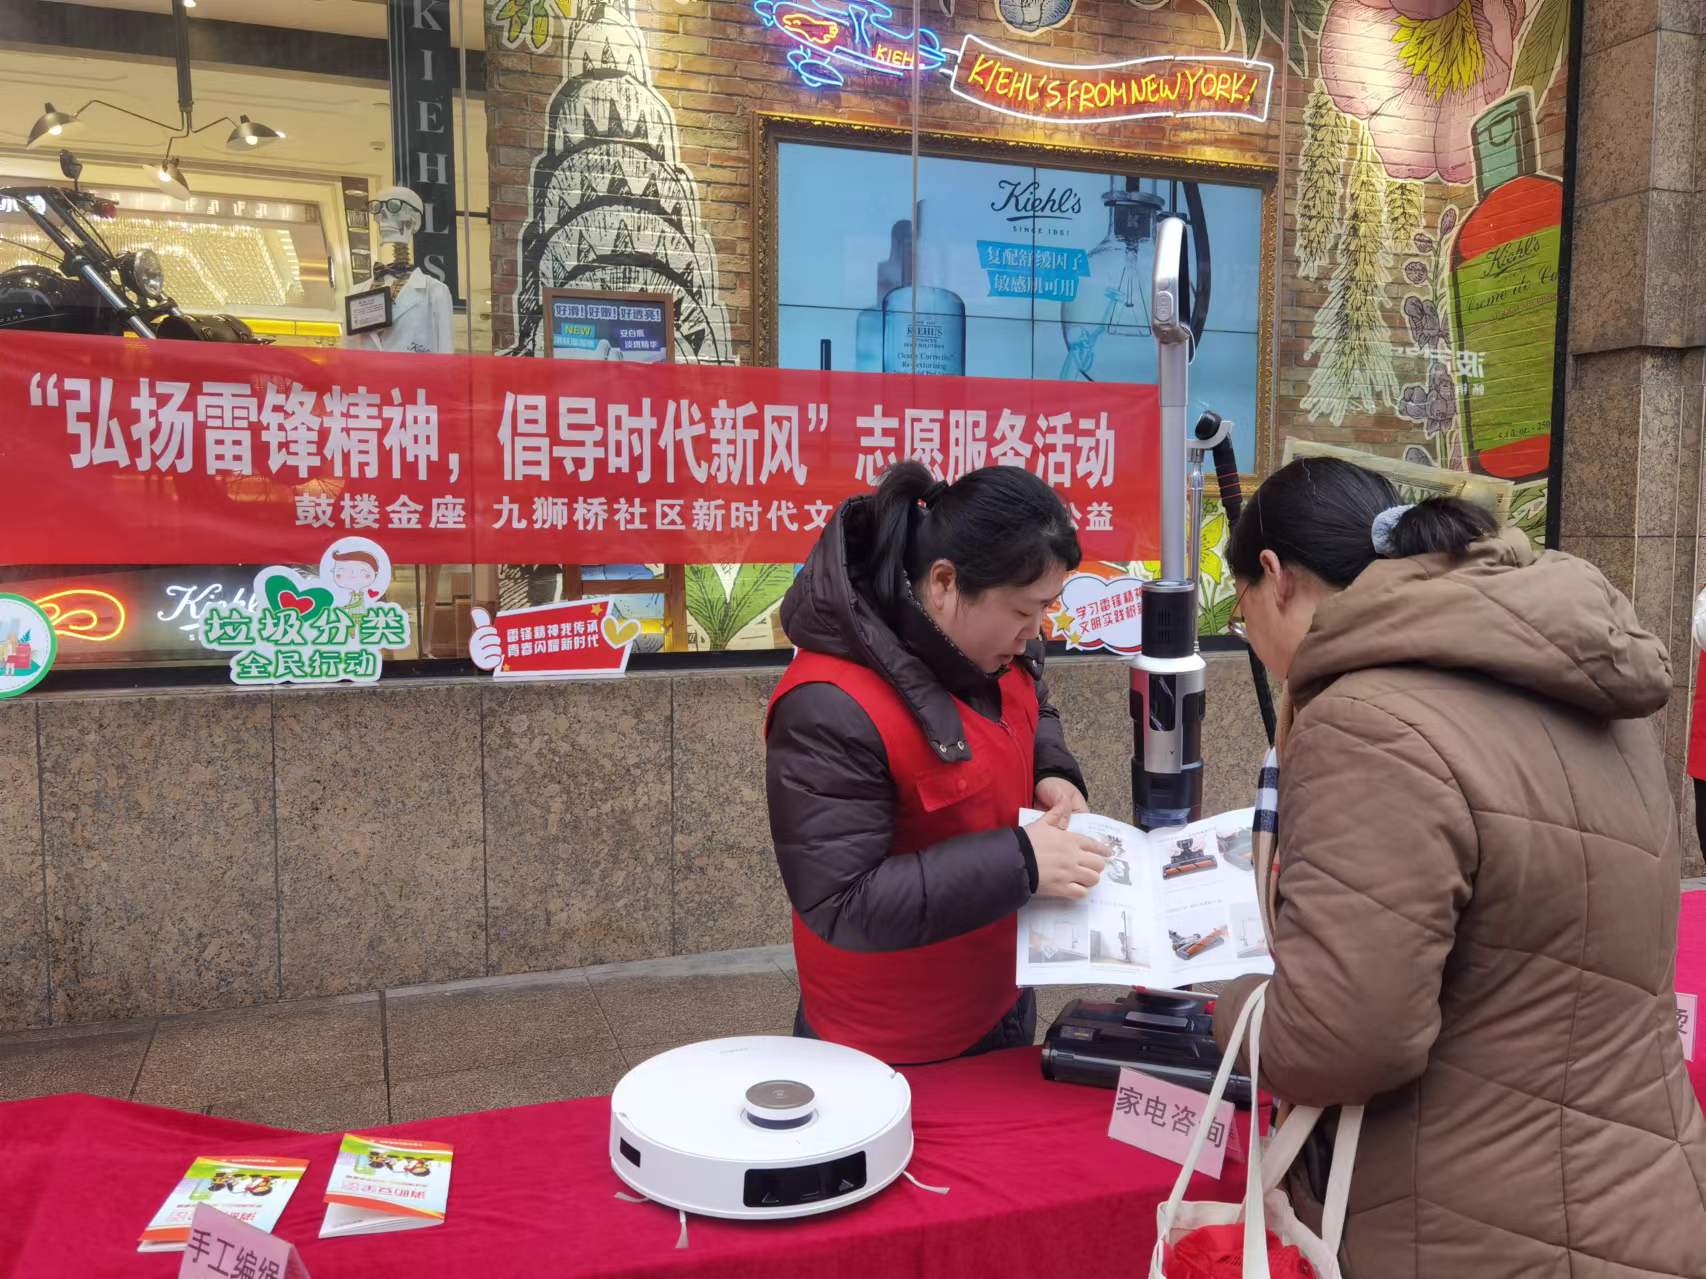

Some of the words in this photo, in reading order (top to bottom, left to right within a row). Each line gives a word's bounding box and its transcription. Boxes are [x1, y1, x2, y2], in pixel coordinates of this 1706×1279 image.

[967, 53, 1063, 109] KIEHL'S
[1067, 81, 1127, 112] FROM
[1131, 73, 1182, 105] NEW
[1184, 67, 1260, 103] YORK!
[990, 179, 1081, 214] Kiehl's
[1483, 235, 1540, 276] Kiehl's
[564, 324, 592, 337] NEW
[855, 404, 1115, 489] 志愿服务活动
[294, 492, 467, 529] 鼓楼金座
[492, 495, 833, 532] 九狮桥社区新时代文
[205, 607, 405, 646] 垃圾分类
[507, 619, 600, 643] 雷锋精神我传承
[236, 650, 377, 679] 全民行动
[507, 634, 600, 658] 青春闪耀新时代
